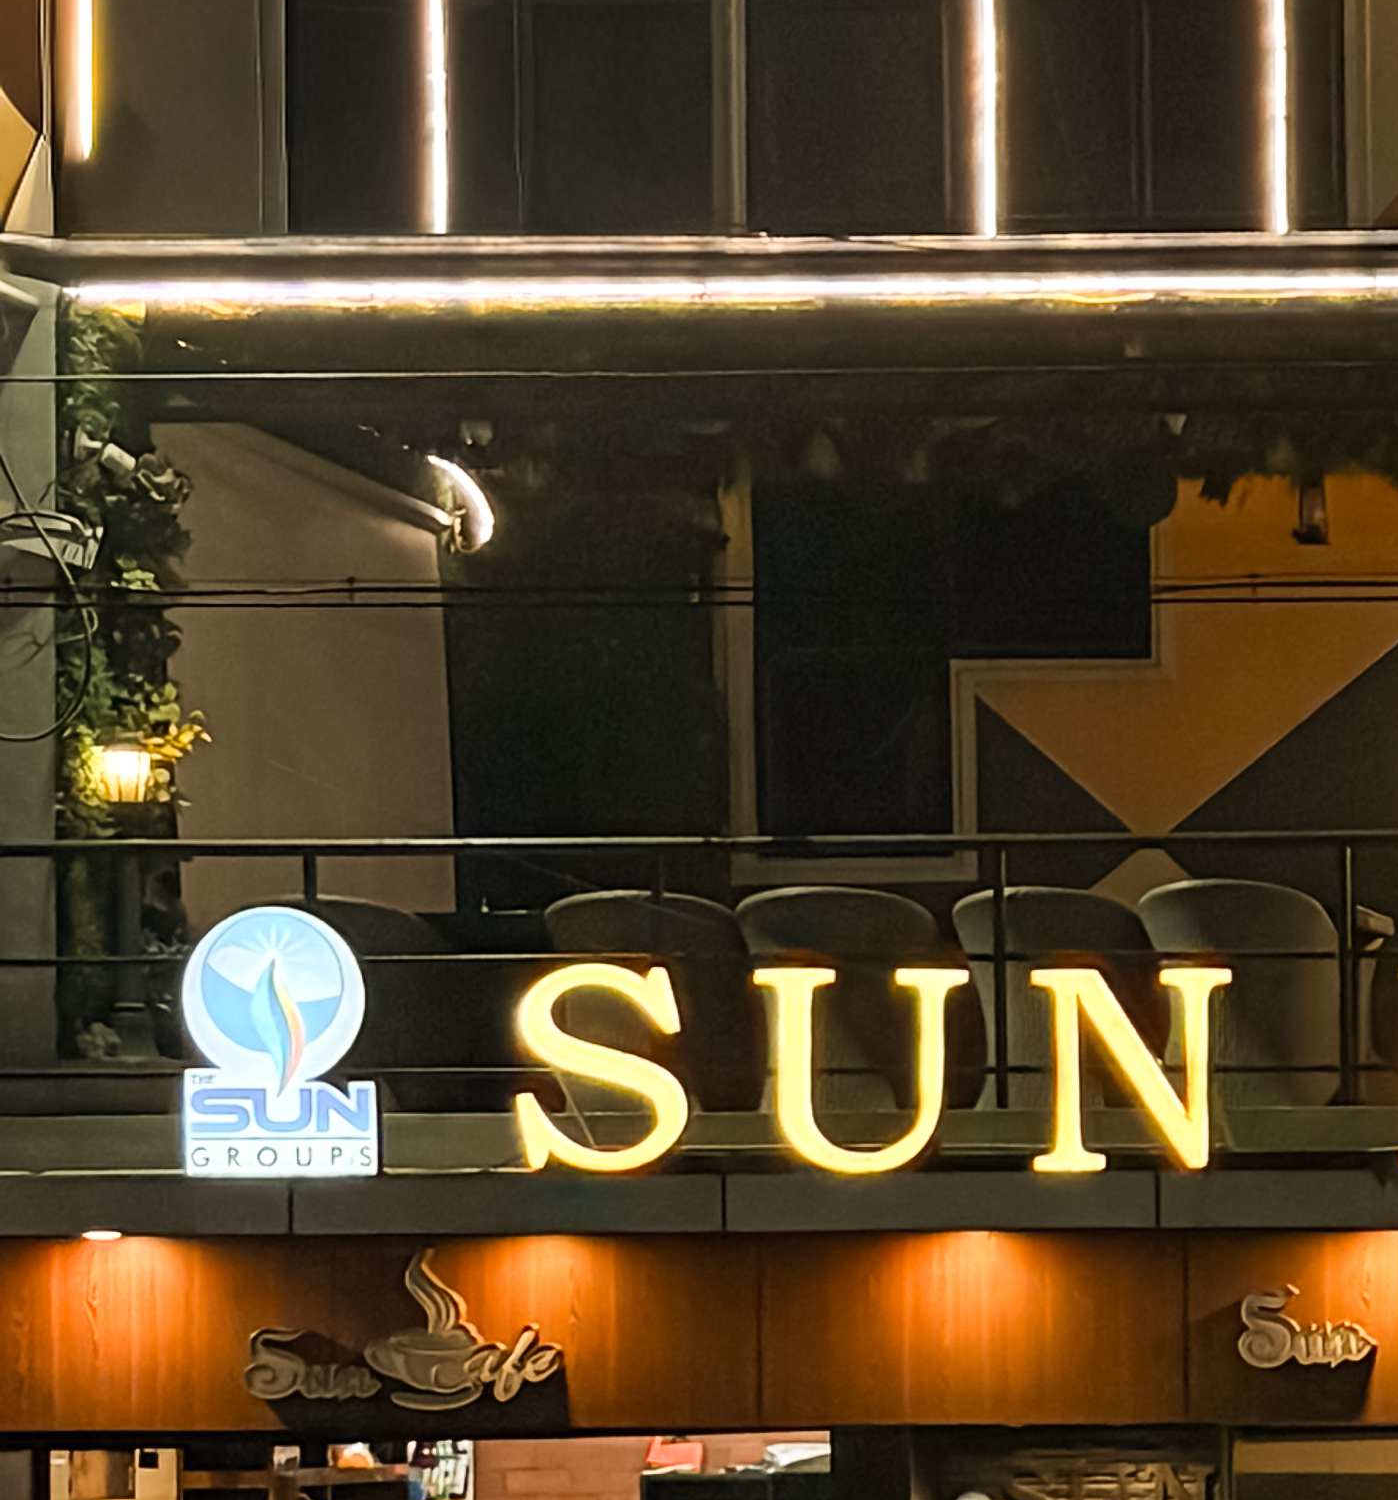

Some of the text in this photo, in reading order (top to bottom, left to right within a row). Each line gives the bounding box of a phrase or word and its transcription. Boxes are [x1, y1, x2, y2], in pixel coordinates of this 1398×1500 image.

[513, 961, 1233, 1175] SUN
[190, 1087, 371, 1132] SUN
[191, 1146, 373, 1167] GROUPS
[1237, 1291, 1378, 1369] Sun
